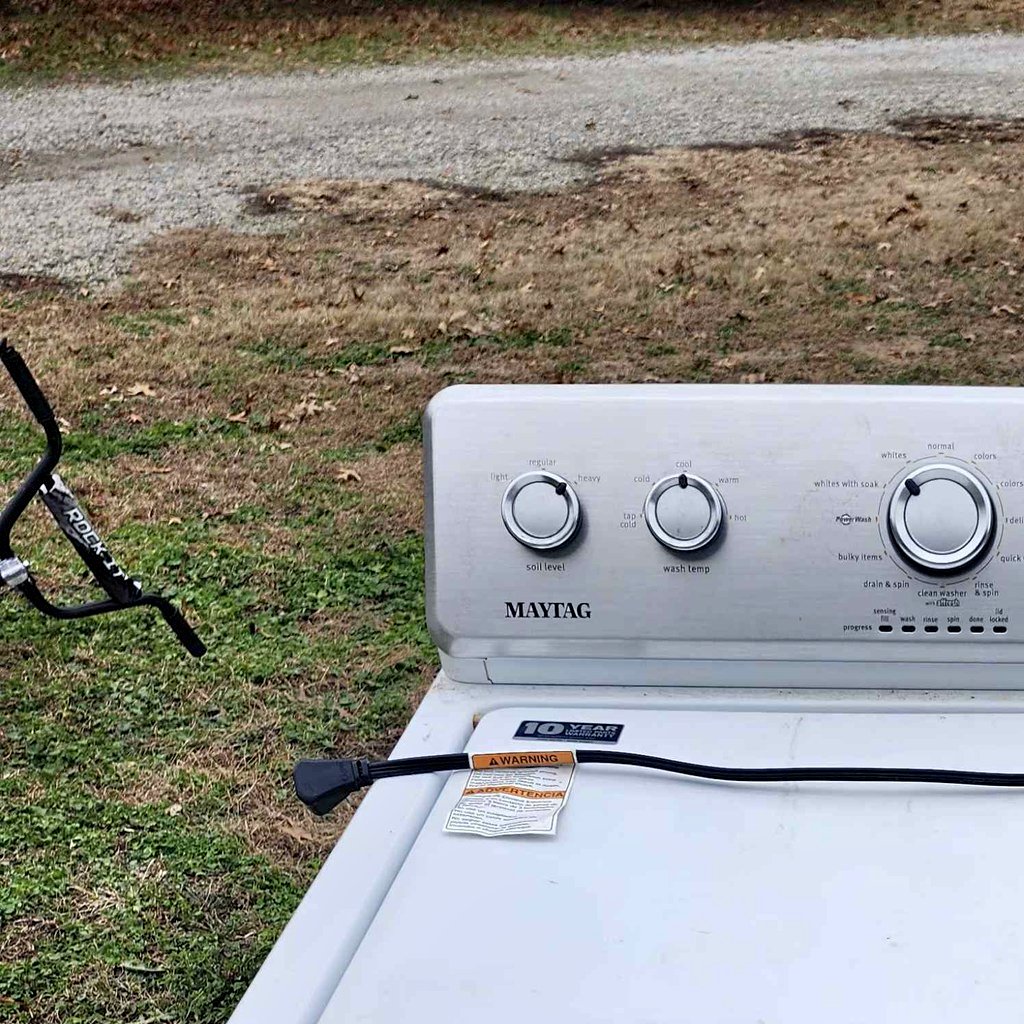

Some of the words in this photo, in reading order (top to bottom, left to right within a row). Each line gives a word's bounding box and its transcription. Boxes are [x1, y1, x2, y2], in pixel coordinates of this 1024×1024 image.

[927, 442, 955, 451] normal
[881, 451, 907, 460] whites
[974, 452, 997, 461] colors
[529, 459, 556, 467] regular
[675, 460, 692, 468] cool
[491, 474, 508, 483] light
[578, 475, 601, 483] heavy
[634, 474, 650, 483] cold
[814, 479, 840, 488] whites
[842, 479, 858, 488] with
[860, 480, 879, 489] soak
[1000, 479, 1023, 488] colors
[623, 512, 636, 521] tap
[734, 513, 747, 522] hot
[620, 520, 637, 529] cold
[838, 552, 858, 563] bulky
[861, 553, 882, 562] items
[1000, 552, 1023, 564] quick
[526, 562, 542, 572] soil
[544, 562, 566, 572] level
[663, 565, 686, 574] wash
[688, 564, 710, 575] temp
[863, 579, 884, 588] drain
[892, 579, 910, 590] spin
[974, 581, 994, 590] rinse
[917, 590, 938, 598] clean
[940, 590, 967, 598] washer
[982, 588, 1000, 599] spin
[504, 601, 592, 619] MAYTAG
[873, 608, 896, 616] sensing
[994, 607, 1004, 615] lid
[880, 615, 890, 623] fill
[900, 615, 916, 623] wash
[946, 616, 961, 625] spin
[968, 615, 985, 623] done
[989, 614, 1009, 623] locked
[843, 625, 873, 634] progress
[523, 721, 565, 736] 10
[569, 723, 619, 732] YEAR
[499, 754, 559, 766] WARNING
[476, 786, 564, 798] ADVERTENCIA
